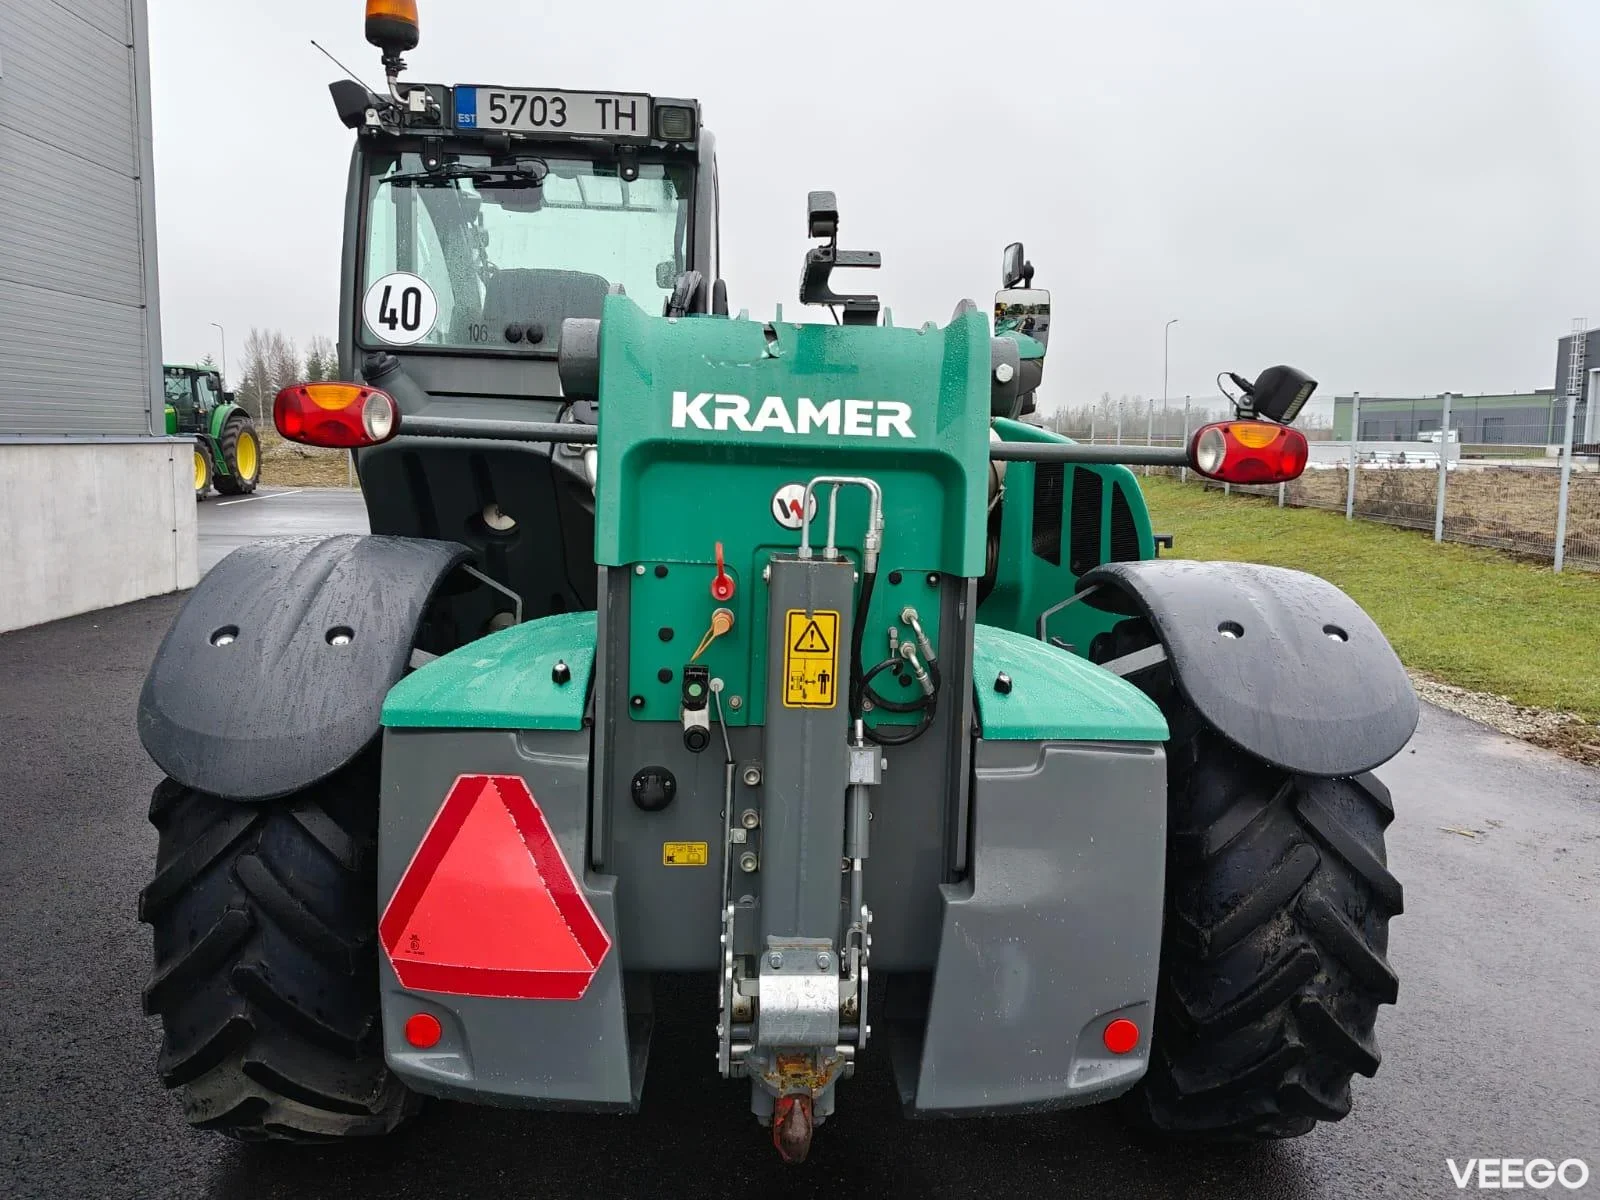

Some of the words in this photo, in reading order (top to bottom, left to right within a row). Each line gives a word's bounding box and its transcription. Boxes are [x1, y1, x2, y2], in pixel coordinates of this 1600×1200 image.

[457, 113, 477, 124] EST
[489, 93, 567, 128] 5703
[595, 98, 637, 132] TH
[378, 284, 421, 332] 40
[468, 323, 488, 342] 106
[671, 391, 917, 439] KRAMER
